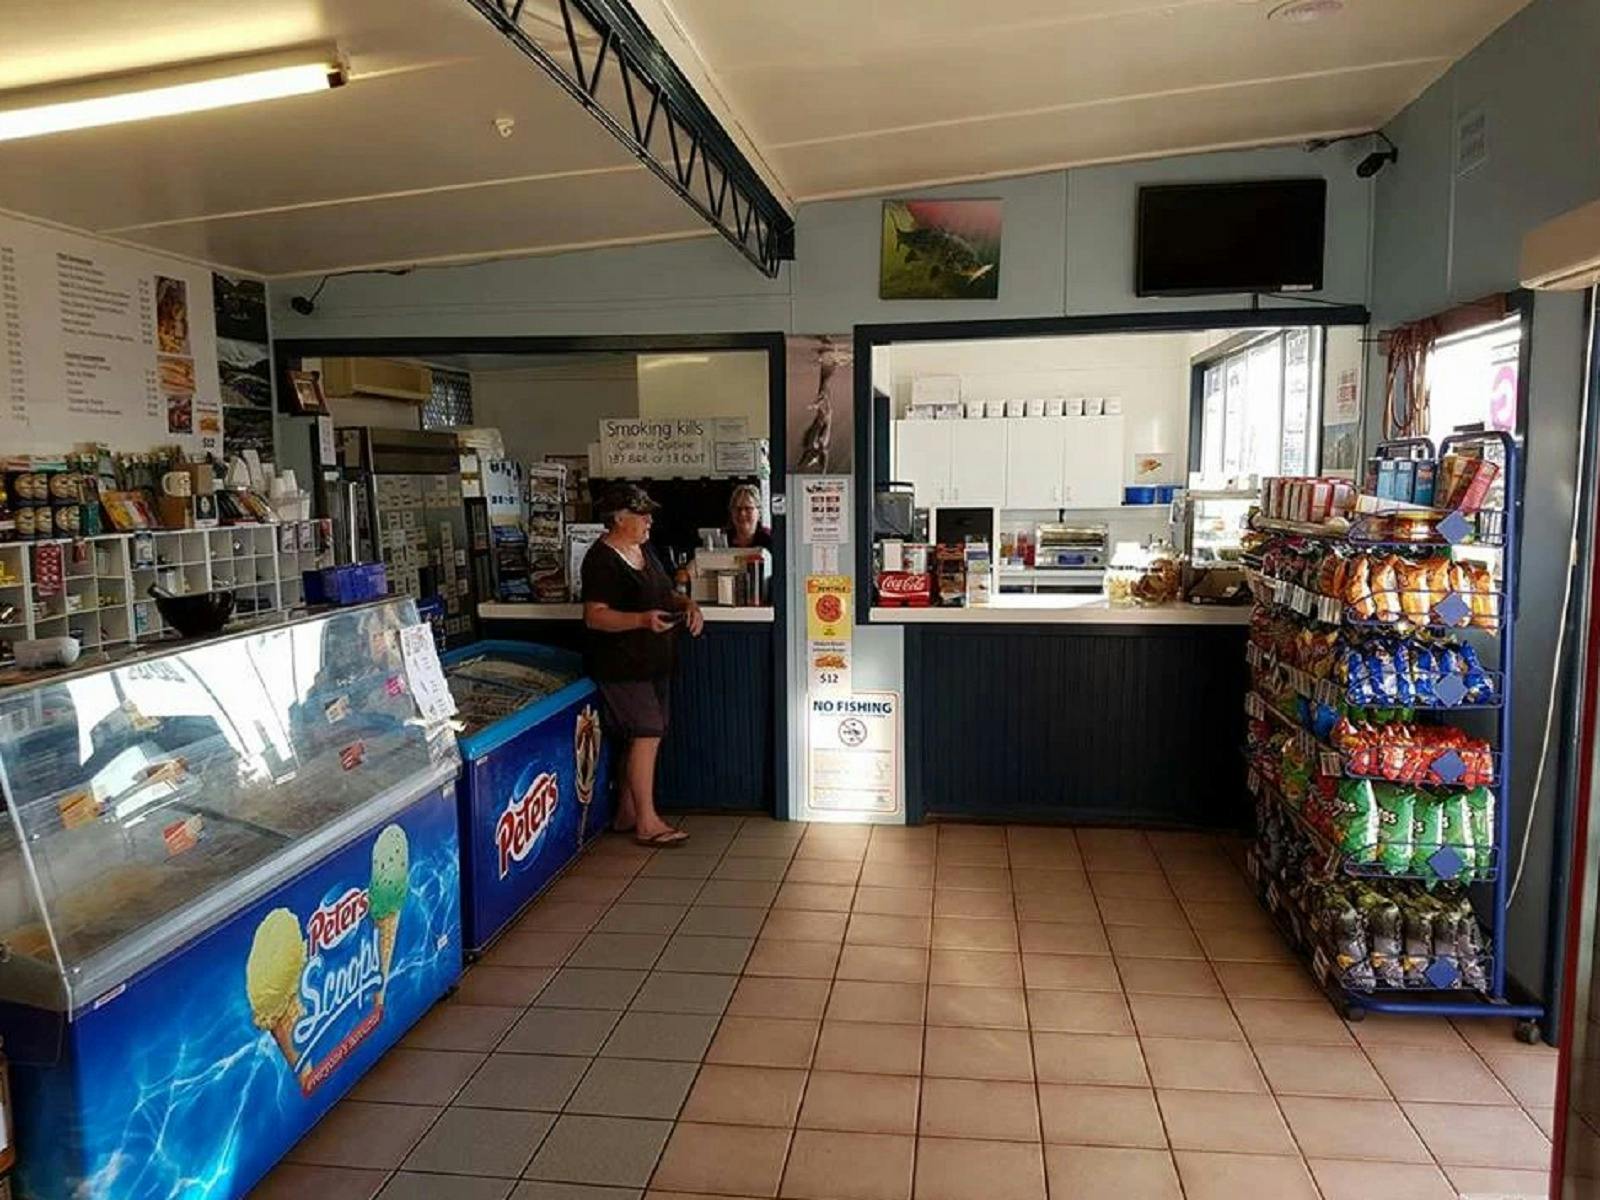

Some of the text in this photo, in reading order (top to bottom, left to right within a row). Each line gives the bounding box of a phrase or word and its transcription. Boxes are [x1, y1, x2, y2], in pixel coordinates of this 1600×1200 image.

[606, 420, 672, 440] Smoking
[820, 673, 839, 684] $12
[813, 700, 893, 714] NO FISHING
[293, 927, 382, 1045] Scoops
